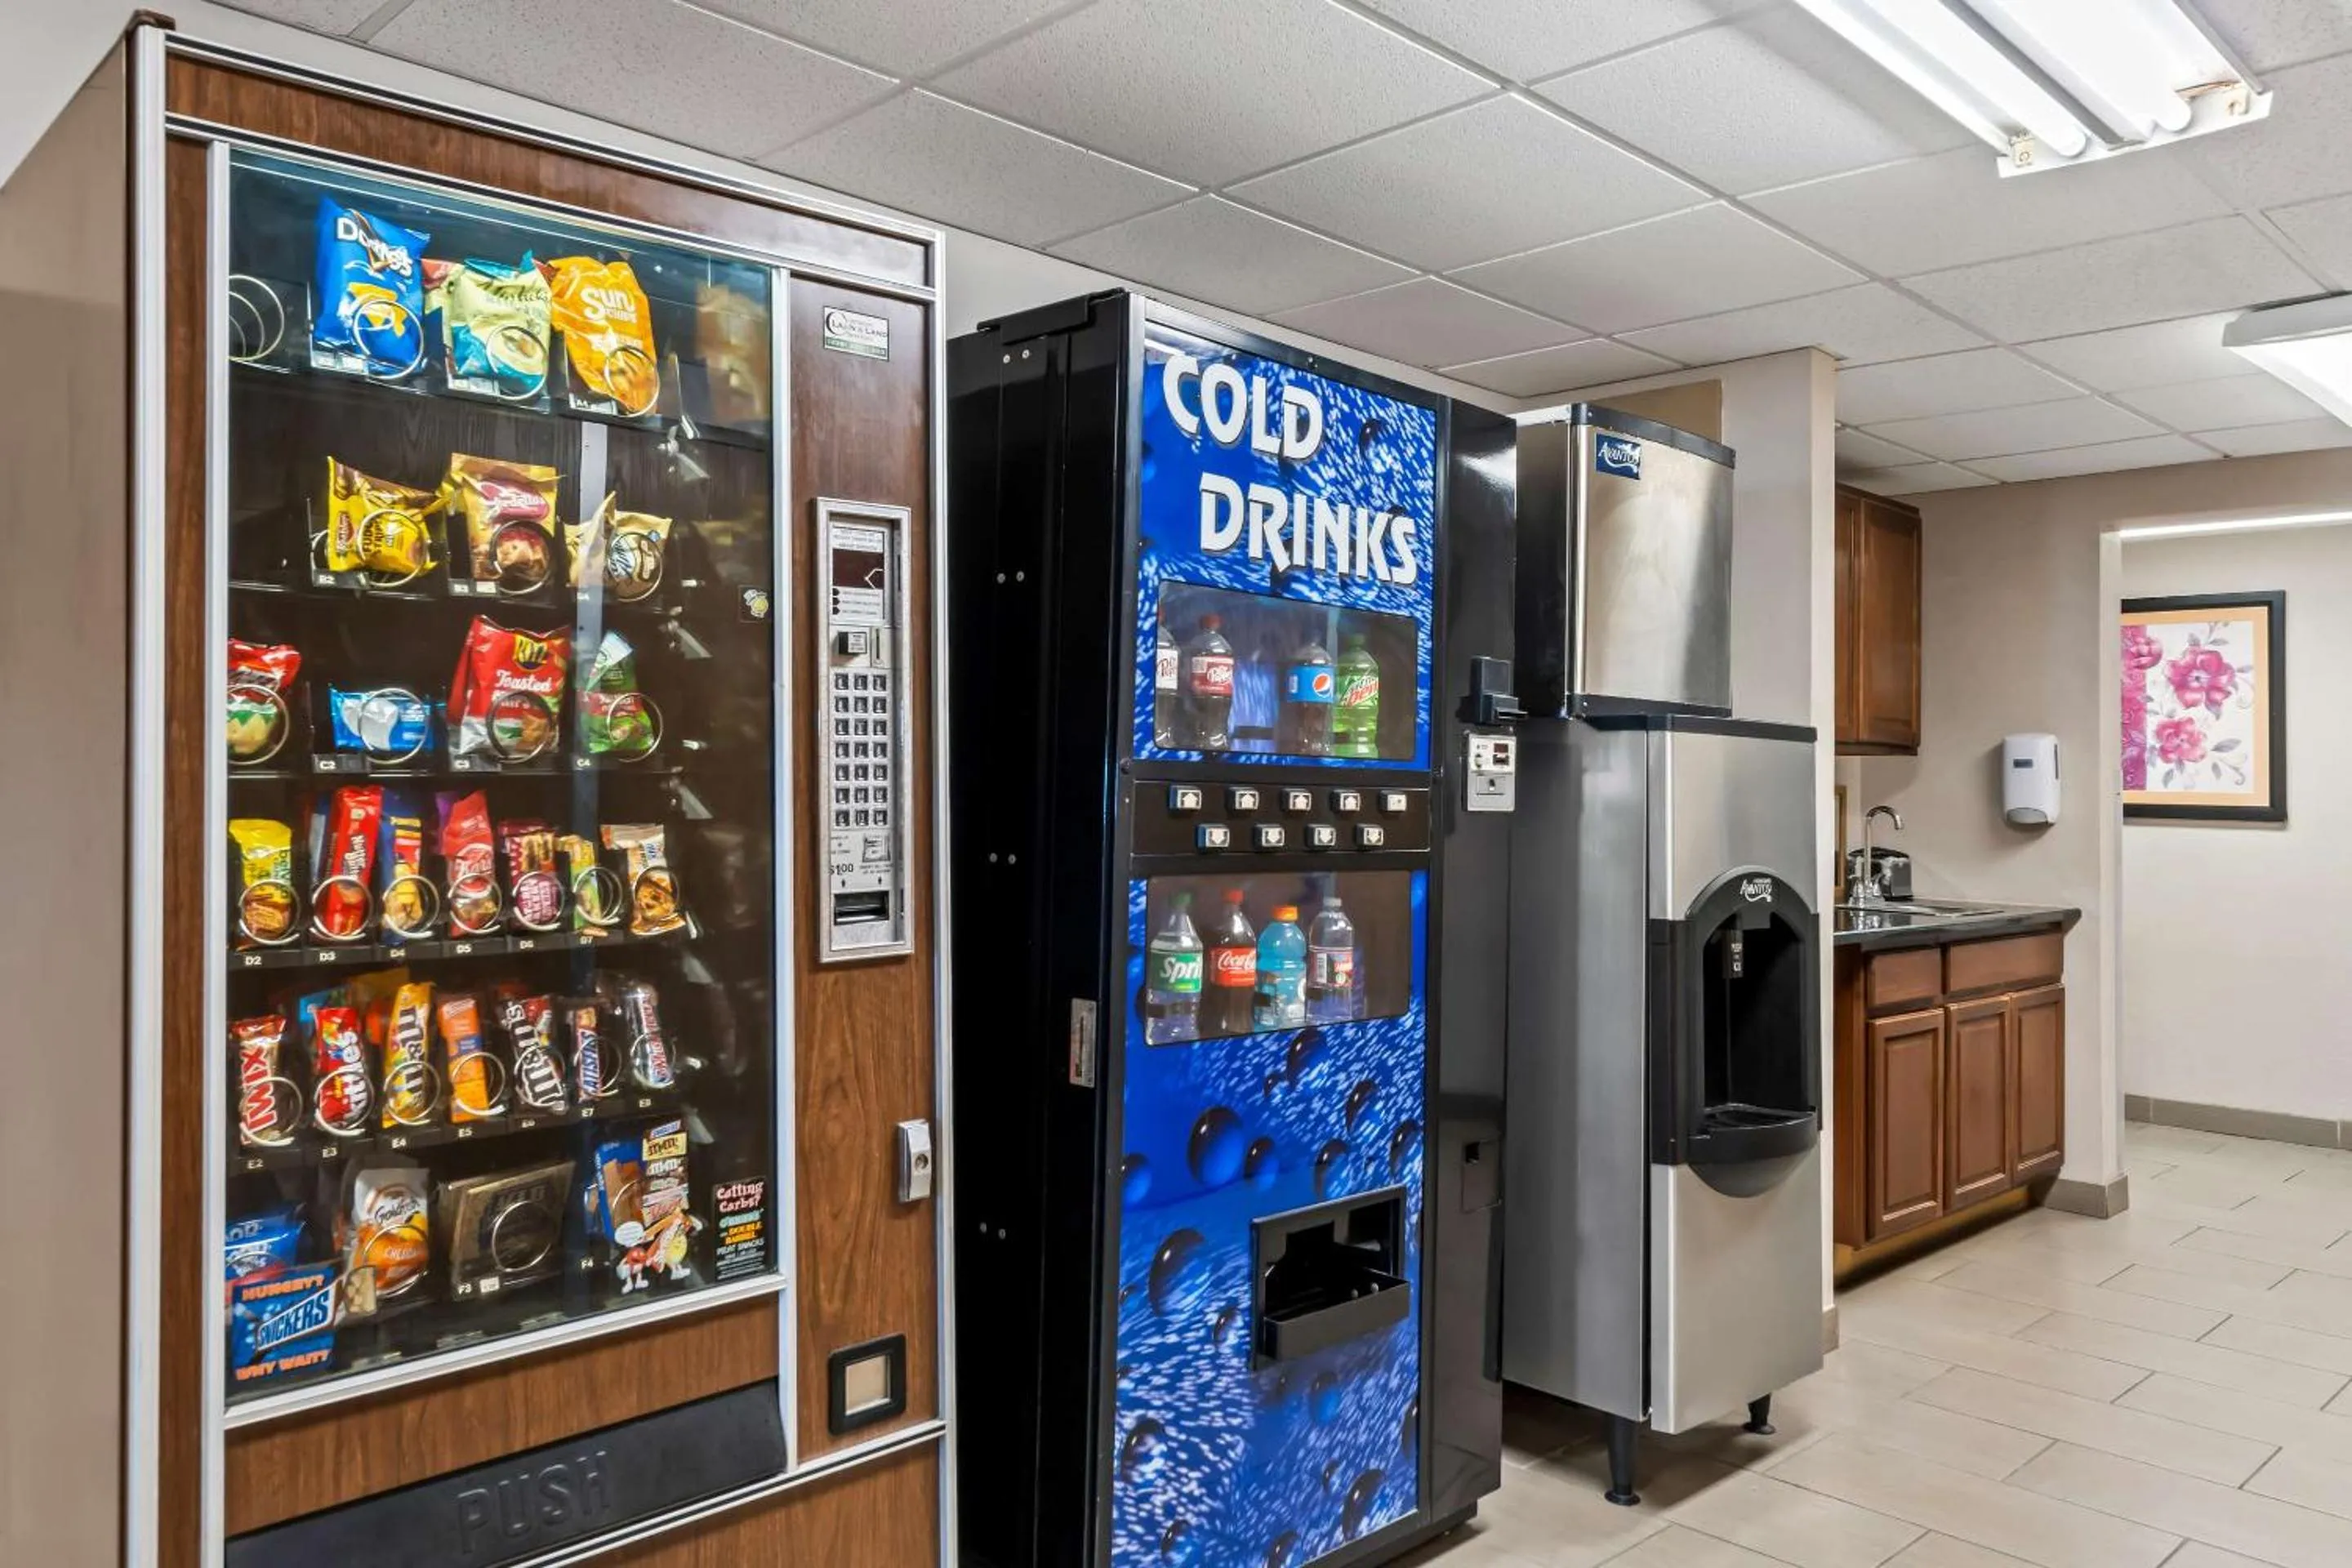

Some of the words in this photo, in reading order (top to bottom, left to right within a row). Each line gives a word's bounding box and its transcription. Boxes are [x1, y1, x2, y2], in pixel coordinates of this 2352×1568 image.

[1163, 354, 1324, 460] COLD
[1200, 472, 1419, 585] DRINKS
[495, 669, 553, 692] Toasted
[245, 956, 262, 966] D2
[1160, 956, 1202, 983] Spri
[240, 1045, 278, 1133] TWIX
[457, 1128, 473, 1138] E5
[260, 1290, 328, 1346] SNICKERS
[457, 1450, 611, 1555] PUSH
